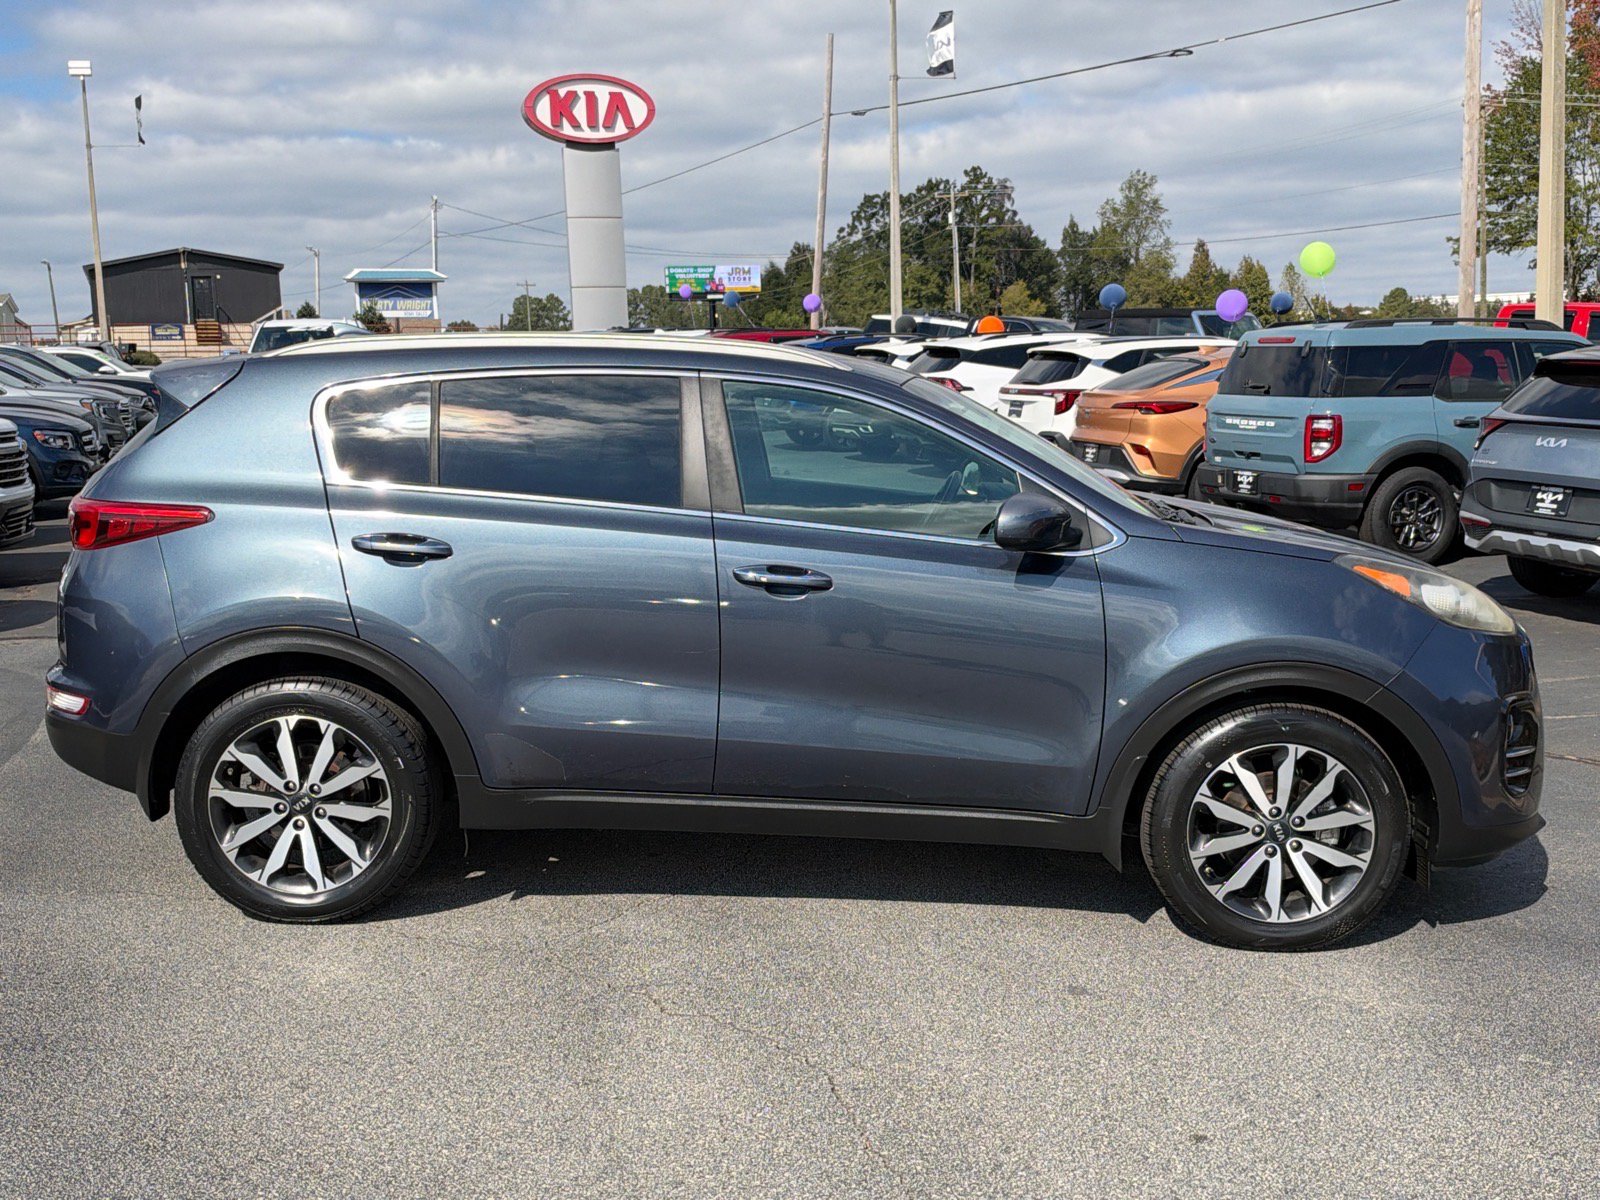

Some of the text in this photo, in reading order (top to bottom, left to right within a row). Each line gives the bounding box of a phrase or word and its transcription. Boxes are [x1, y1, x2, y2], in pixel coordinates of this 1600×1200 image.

[547, 89, 635, 130] KIA
[727, 266, 751, 276] JRM
[397, 300, 432, 311] WRIGHT
[1225, 418, 1275, 427] BRONCO
[1535, 436, 1568, 448] KIA
[1536, 491, 1564, 501] KIA
[293, 796, 311, 811] KIA
[1273, 823, 1285, 841] KIA
